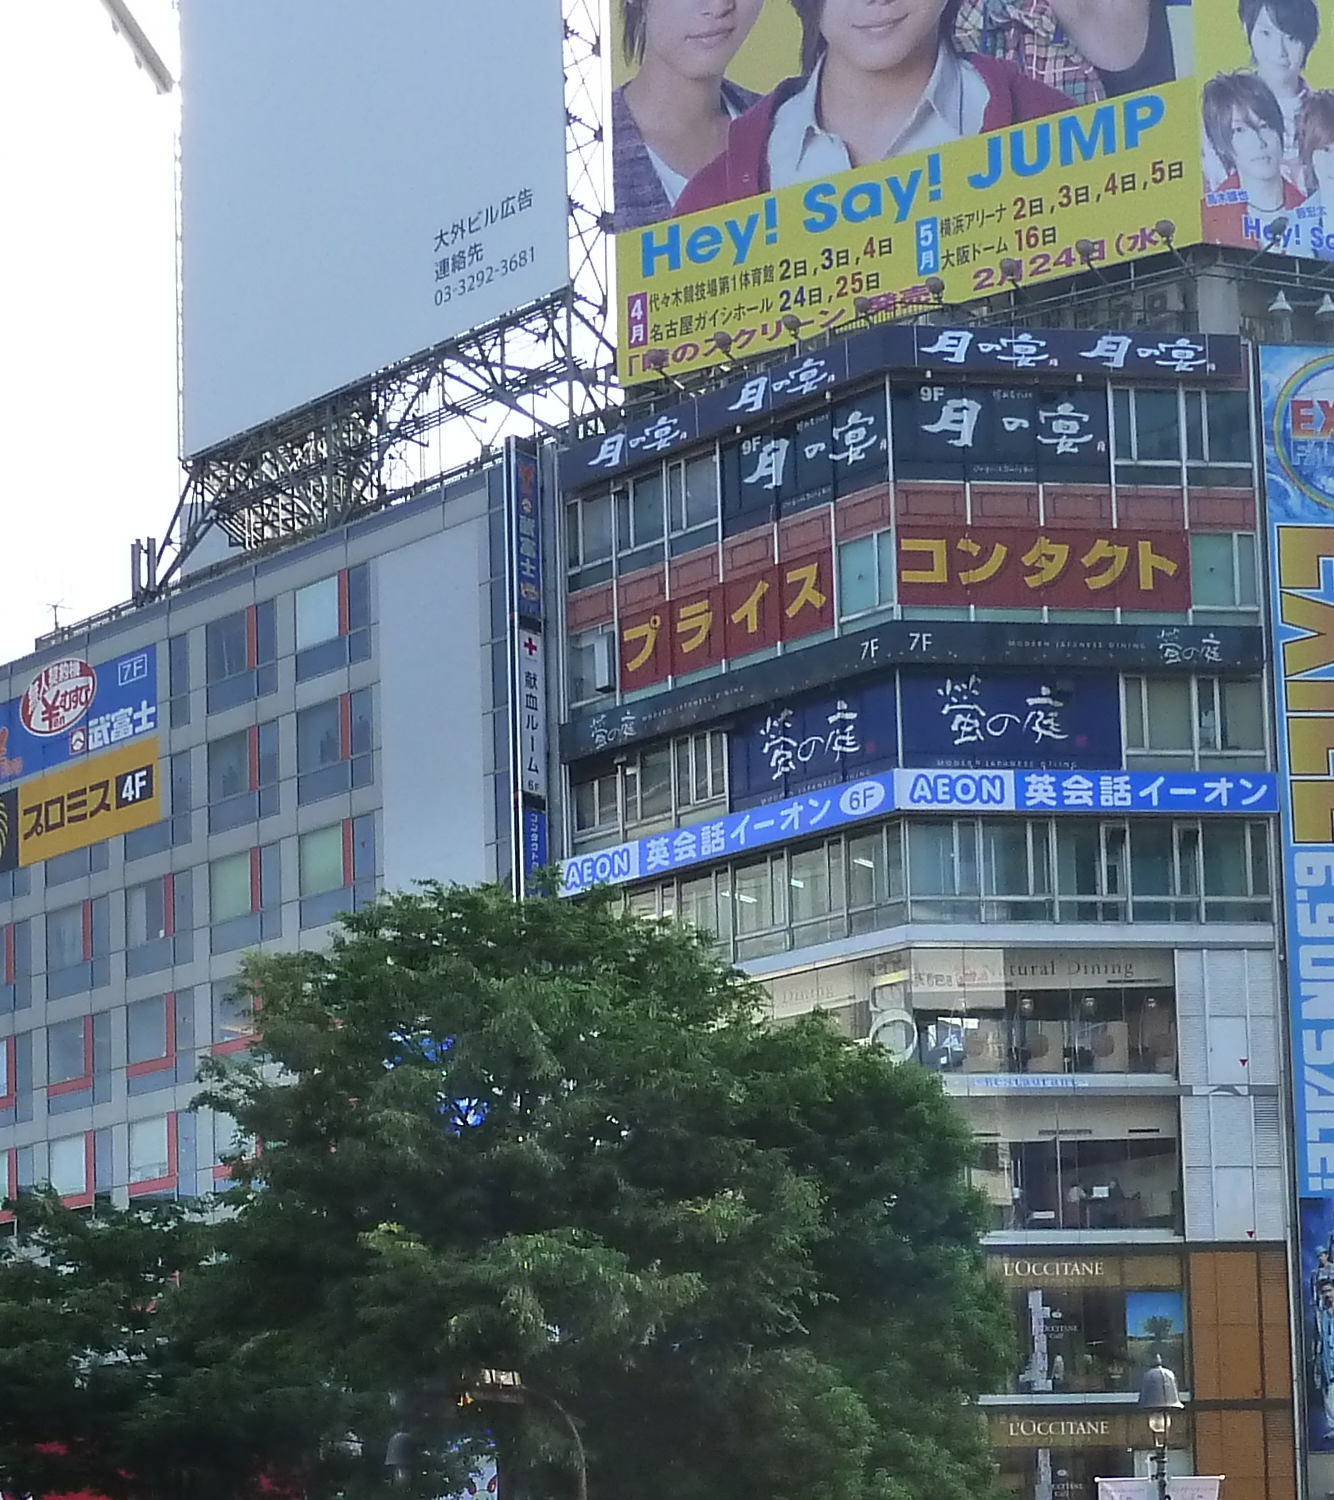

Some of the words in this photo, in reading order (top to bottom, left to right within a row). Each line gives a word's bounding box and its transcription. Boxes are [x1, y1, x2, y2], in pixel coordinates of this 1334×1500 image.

[640, 197, 778, 278] Hey!
[802, 153, 941, 234] Say!
[967, 94, 1166, 190] JUMP
[433, 187, 533, 252] 大外ビル広告
[939, 203, 1007, 238] 横浜アリーナ
[434, 242, 484, 282] 連絡先
[919, 224, 934, 270] 5月
[941, 237, 1008, 271] 大阪ドーム
[434, 246, 536, 306] 03-3292-3681
[630, 299, 645, 343] 4月
[650, 298, 773, 343] 名古屋ガイシホール
[921, 331, 1050, 366] 月の宴
[1079, 336, 1207, 371] 月の宴
[727, 358, 829, 412] 月の宴
[920, 386, 944, 401] 9F
[588, 416, 679, 466] 月の宴
[742, 436, 761, 455] 9F
[922, 398, 1093, 454] 月の宴
[744, 411, 877, 489] 月の宴
[900, 535, 1177, 590] コンタクト
[624, 562, 826, 672] プライス
[861, 639, 879, 660] 7F
[909, 633, 933, 651] 7F
[122, 660, 144, 681] 7F
[88, 700, 156, 751] 武富士
[524, 671, 540, 774] 献血ルーム
[23, 780, 111, 840] プロミス
[121, 770, 147, 801] 4F
[911, 776, 1003, 803] AEON
[1024, 773, 1267, 807] 英会話イーオン
[646, 799, 831, 870] 英会話イーオン
[849, 787, 876, 811] 6F
[566, 850, 631, 891] AEON
[1068, 960, 1135, 977] Dining
[1004, 1260, 1104, 1277] L'OCCITANE
[1009, 1419, 1110, 1436] L'OCCITANE
